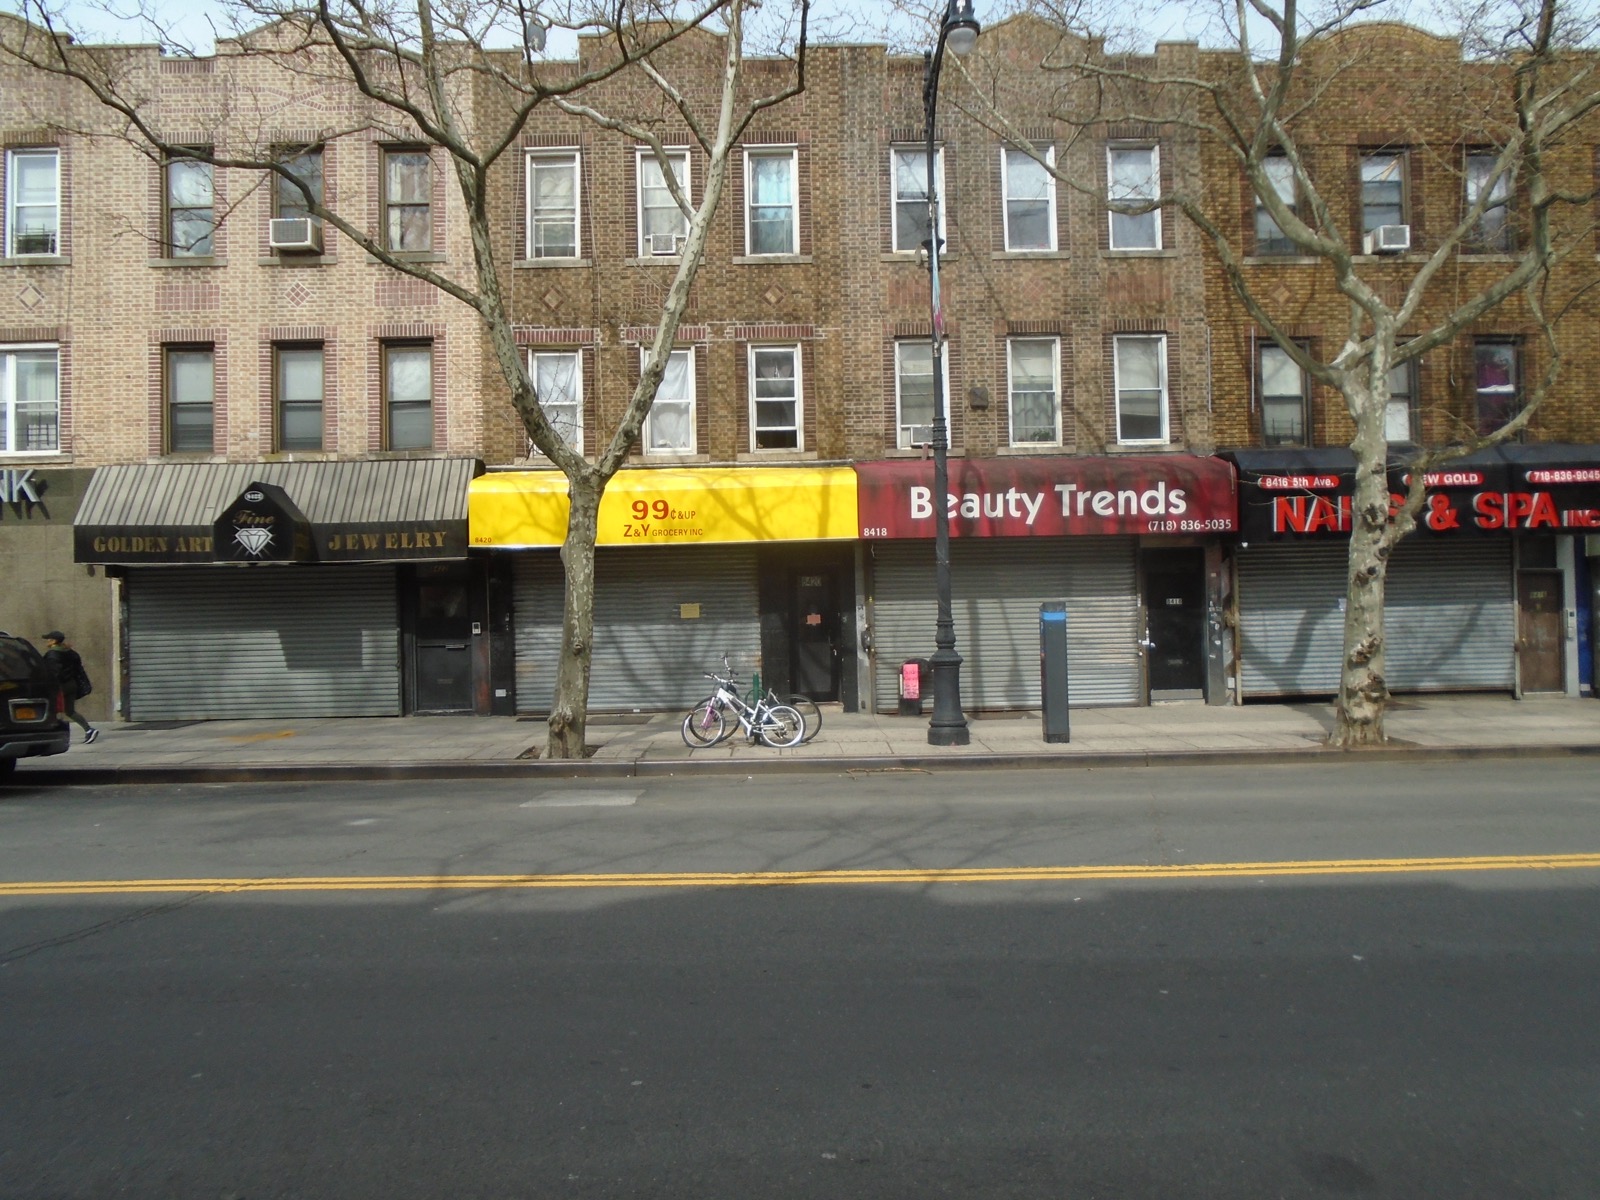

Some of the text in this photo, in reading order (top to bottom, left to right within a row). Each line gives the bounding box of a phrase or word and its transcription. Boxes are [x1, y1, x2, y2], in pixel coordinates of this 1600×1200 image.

[1443, 473, 1478, 484] GOLD
[1533, 470, 1600, 481] 718-836-9045
[1265, 477, 1335, 487] 8416 5th Ave.
[1054, 481, 1187, 517] Trends
[232, 509, 274, 524] Fine
[1273, 495, 1407, 532] NAIS
[1425, 493, 1460, 531] &
[1473, 491, 1561, 529] SPA
[1147, 518, 1232, 532] (718) 836-5035
[651, 528, 689, 537] GROCERY
[689, 528, 704, 536] INC
[863, 527, 888, 537] 8418
[93, 536, 213, 553] GOLDEN ART
[328, 531, 447, 551] JEWELRY
[474, 536, 492, 544] 8420
